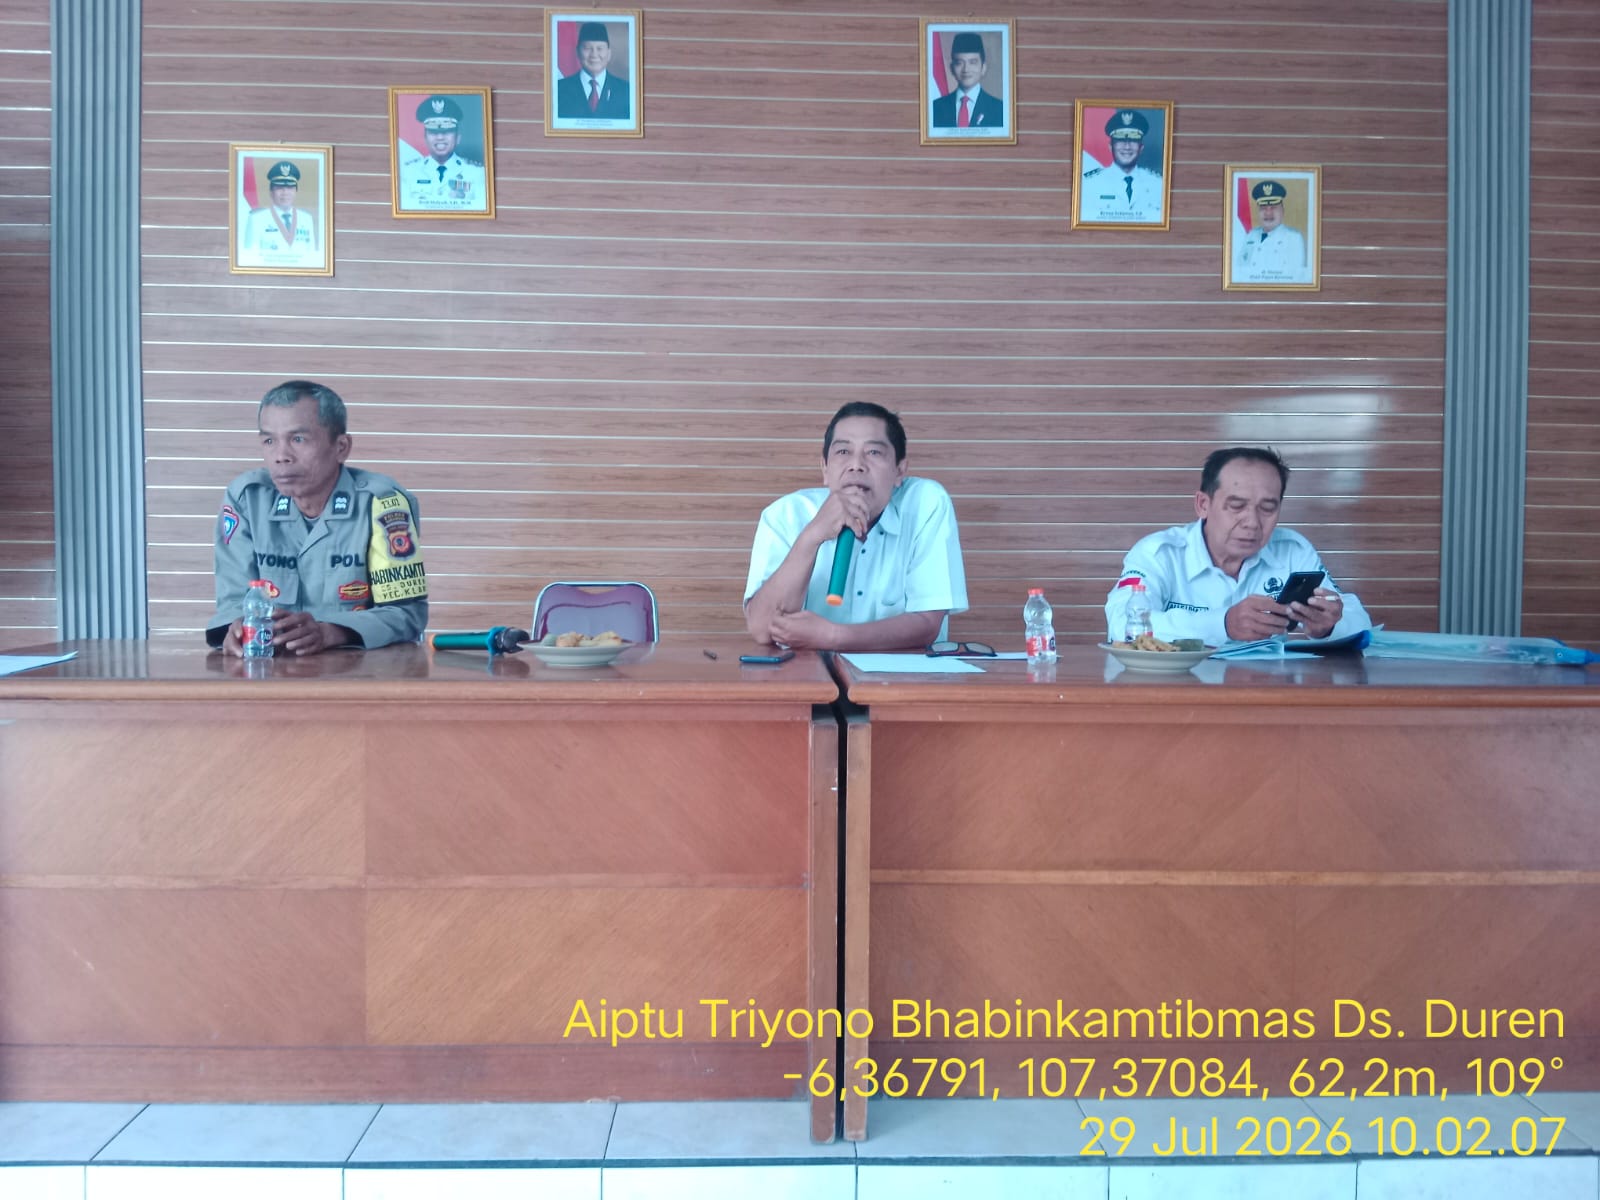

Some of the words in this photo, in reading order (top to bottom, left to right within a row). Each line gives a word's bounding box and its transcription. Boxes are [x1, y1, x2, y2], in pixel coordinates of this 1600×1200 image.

[257, 553, 298, 569] YONO
[331, 553, 365, 568] POL
[370, 562, 425, 585] HABINKAMTI
